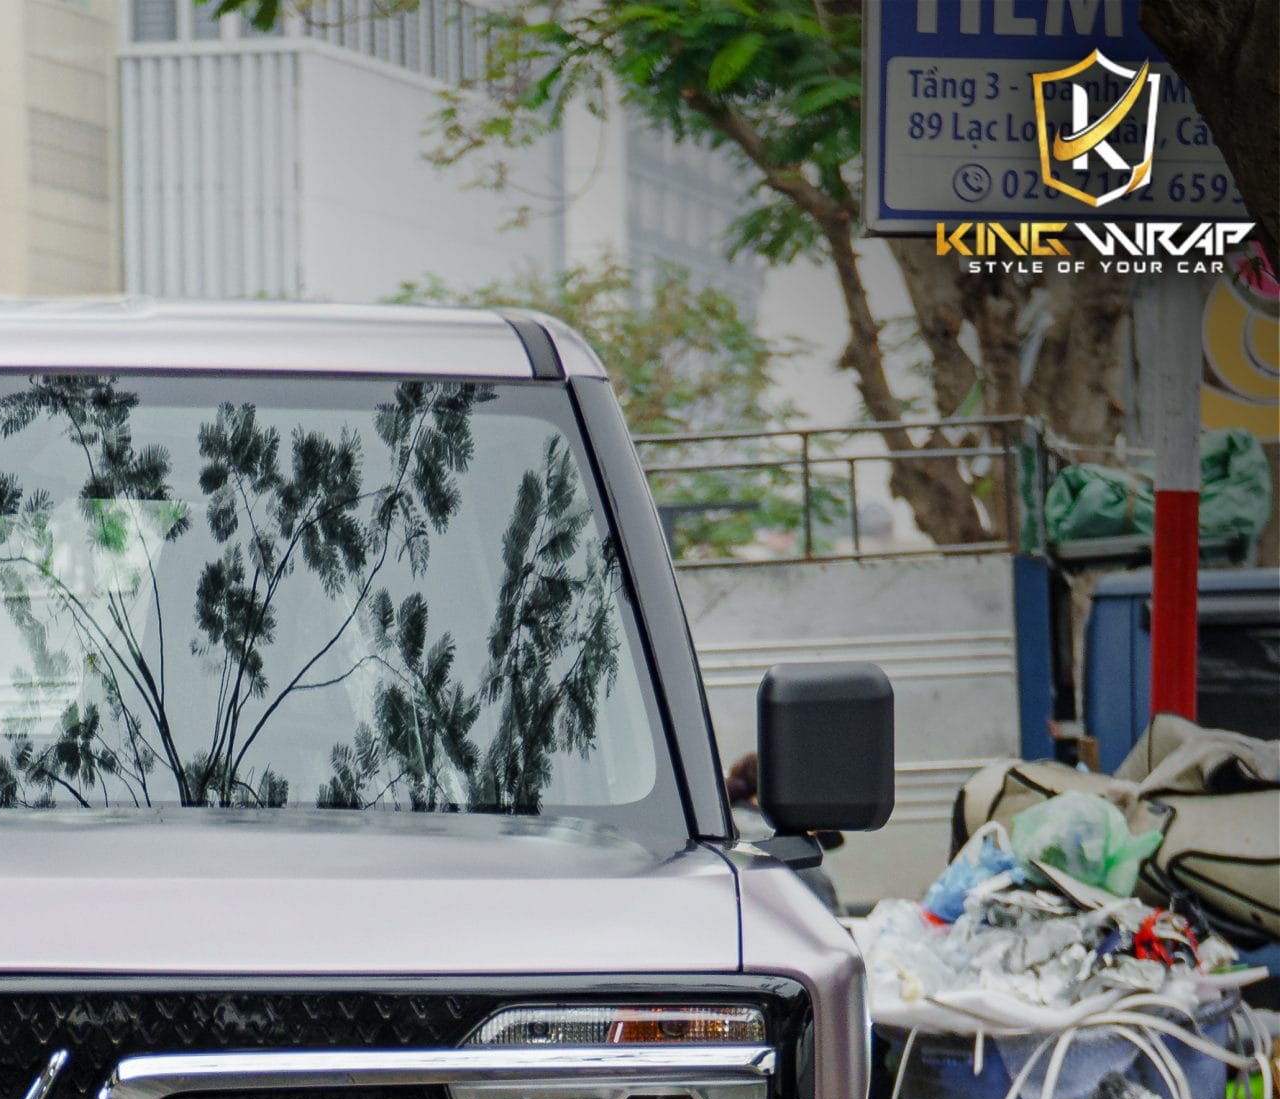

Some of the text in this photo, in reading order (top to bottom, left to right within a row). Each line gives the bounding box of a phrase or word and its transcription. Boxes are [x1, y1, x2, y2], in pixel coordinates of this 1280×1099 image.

[908, 66, 976, 107] Tầng
[984, 71, 1000, 100] 3
[908, 111, 943, 140] 89
[952, 111, 998, 150] Lạc
